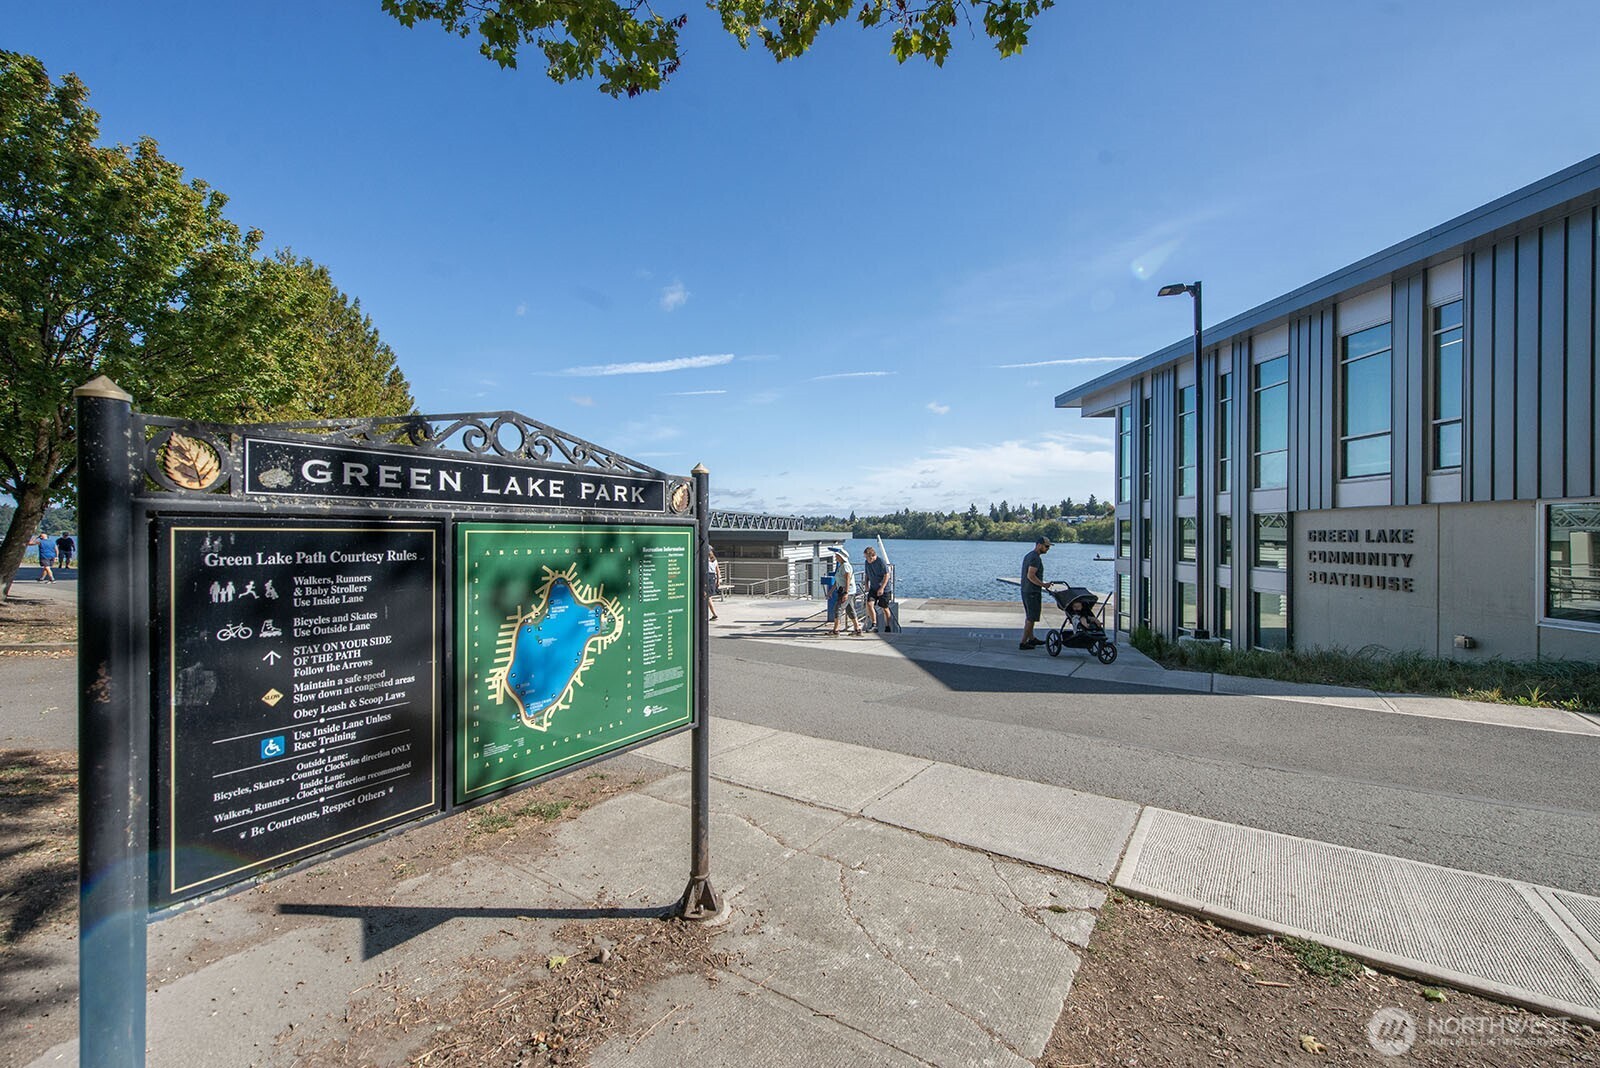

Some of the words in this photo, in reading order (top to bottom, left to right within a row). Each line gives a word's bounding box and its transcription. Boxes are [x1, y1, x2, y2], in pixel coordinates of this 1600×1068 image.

[302, 459, 462, 492] GREEN
[482, 474, 564, 498] LAKE
[580, 482, 645, 503] PARK
[1307, 529, 1359, 542] GREEN
[1365, 529, 1414, 543] LAKE
[204, 552, 252, 566] Green
[256, 552, 293, 565] Lake
[296, 552, 327, 564] Path
[330, 550, 384, 564] Courtesy
[386, 550, 417, 561] Rules
[1308, 550, 1414, 568] COMMUNITY
[293, 576, 334, 585] Walkers,
[336, 575, 372, 583] Runners
[1308, 570, 1414, 592] BOATHOUSE
[293, 587, 302, 596] &
[305, 586, 329, 596] Baby
[330, 584, 367, 594] Strollers
[293, 598, 311, 607] Use
[313, 596, 340, 606] Inside
[342, 595, 364, 603] Lane
[293, 616, 330, 627] Bicycles
[332, 613, 348, 622] and
[350, 612, 378, 621] Skates
[293, 628, 311, 637] Use
[313, 624, 347, 635] Outside
[349, 623, 370, 631] Lane
[293, 644, 320, 656] STAY
[322, 642, 338, 652] ON
[340, 639, 368, 650] YOUR
[370, 635, 392, 646] SIDE
[293, 657, 309, 666] OF
[311, 653, 333, 664] THE
[335, 649, 361, 660] PATH
[293, 667, 324, 678] Follow
[326, 663, 340, 672] the
[342, 659, 373, 670] Arrows
[293, 679, 335, 693] Maintain
[344, 674, 361, 684] safe
[363, 670, 386, 682] speed
[293, 692, 316, 704] Slow
[318, 689, 342, 699] down
[354, 678, 394, 691] congested
[394, 675, 416, 685] areas
[293, 709, 318, 719] Obey
[321, 701, 347, 714] Leash
[348, 699, 357, 708] &
[359, 696, 383, 707] Scoop
[385, 691, 406, 701] Laws
[294, 730, 311, 740] Use
[313, 724, 340, 736] Inside
[342, 720, 364, 730] Lane
[366, 713, 392, 723] Unless
[293, 741, 317, 752] Race
[318, 731, 357, 746] Training
[296, 758, 326, 771] Outside
[327, 753, 349, 763] Lane:
[213, 787, 252, 802] Bicycles,
[253, 777, 285, 791] Skaters
[291, 767, 323, 781] Counter
[324, 758, 360, 772] Clockwise
[361, 751, 390, 763] direction
[391, 743, 412, 755] ONLY
[300, 778, 323, 790] Inside
[325, 772, 346, 783] Lane:
[213, 807, 253, 823] Walkers,
[254, 797, 290, 812] Runners
[296, 785, 334, 800] Clockwise
[335, 775, 366, 789] direction
[367, 761, 412, 779] recommended
[250, 826, 265, 837] Be
[267, 811, 320, 832] Courteous,
[321, 798, 356, 815] Respect
[357, 789, 386, 804] Others
